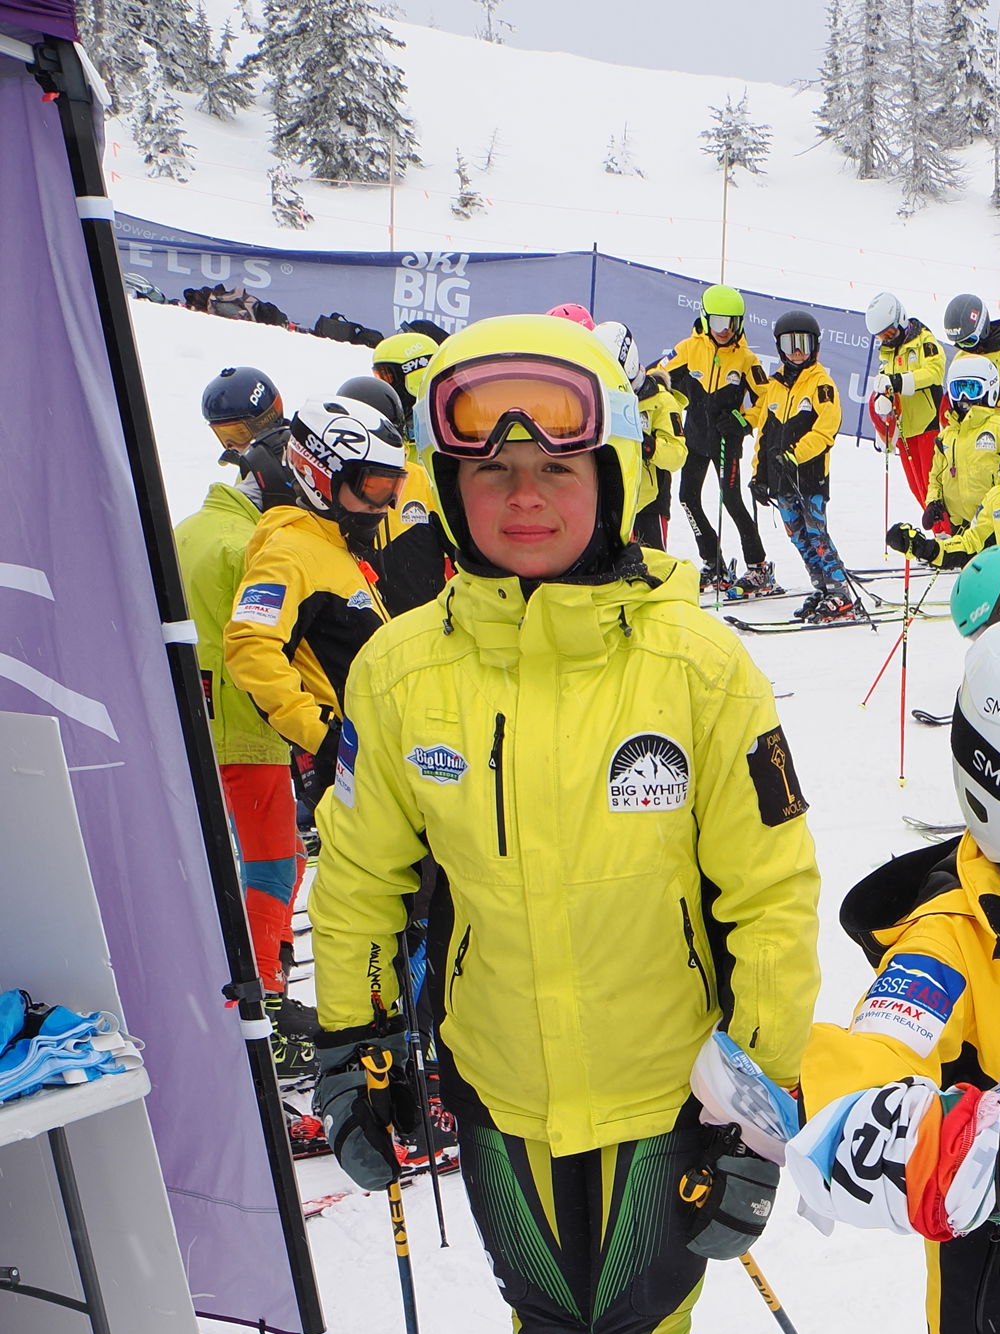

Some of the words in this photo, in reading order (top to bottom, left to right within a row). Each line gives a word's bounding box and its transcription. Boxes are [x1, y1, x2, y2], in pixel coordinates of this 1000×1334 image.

[129, 242, 272, 288] ELUS
[393, 267, 471, 318] BIG
[749, 313, 768, 325] the
[828, 329, 870, 349] TELUS
[401, 359, 420, 374] SPY
[250, 382, 265, 406] poc
[305, 434, 332, 460] SPY
[766, 732, 781, 750] JOAN
[611, 785, 636, 796] BIG
[643, 782, 688, 796] WHITE
[612, 797, 639, 806] SKI
[782, 800, 806, 817] WOLF
[869, 999, 921, 1021] RE/MAX
[865, 1011, 892, 1020] WHITE
[892, 1015, 934, 1041] REALTOR
